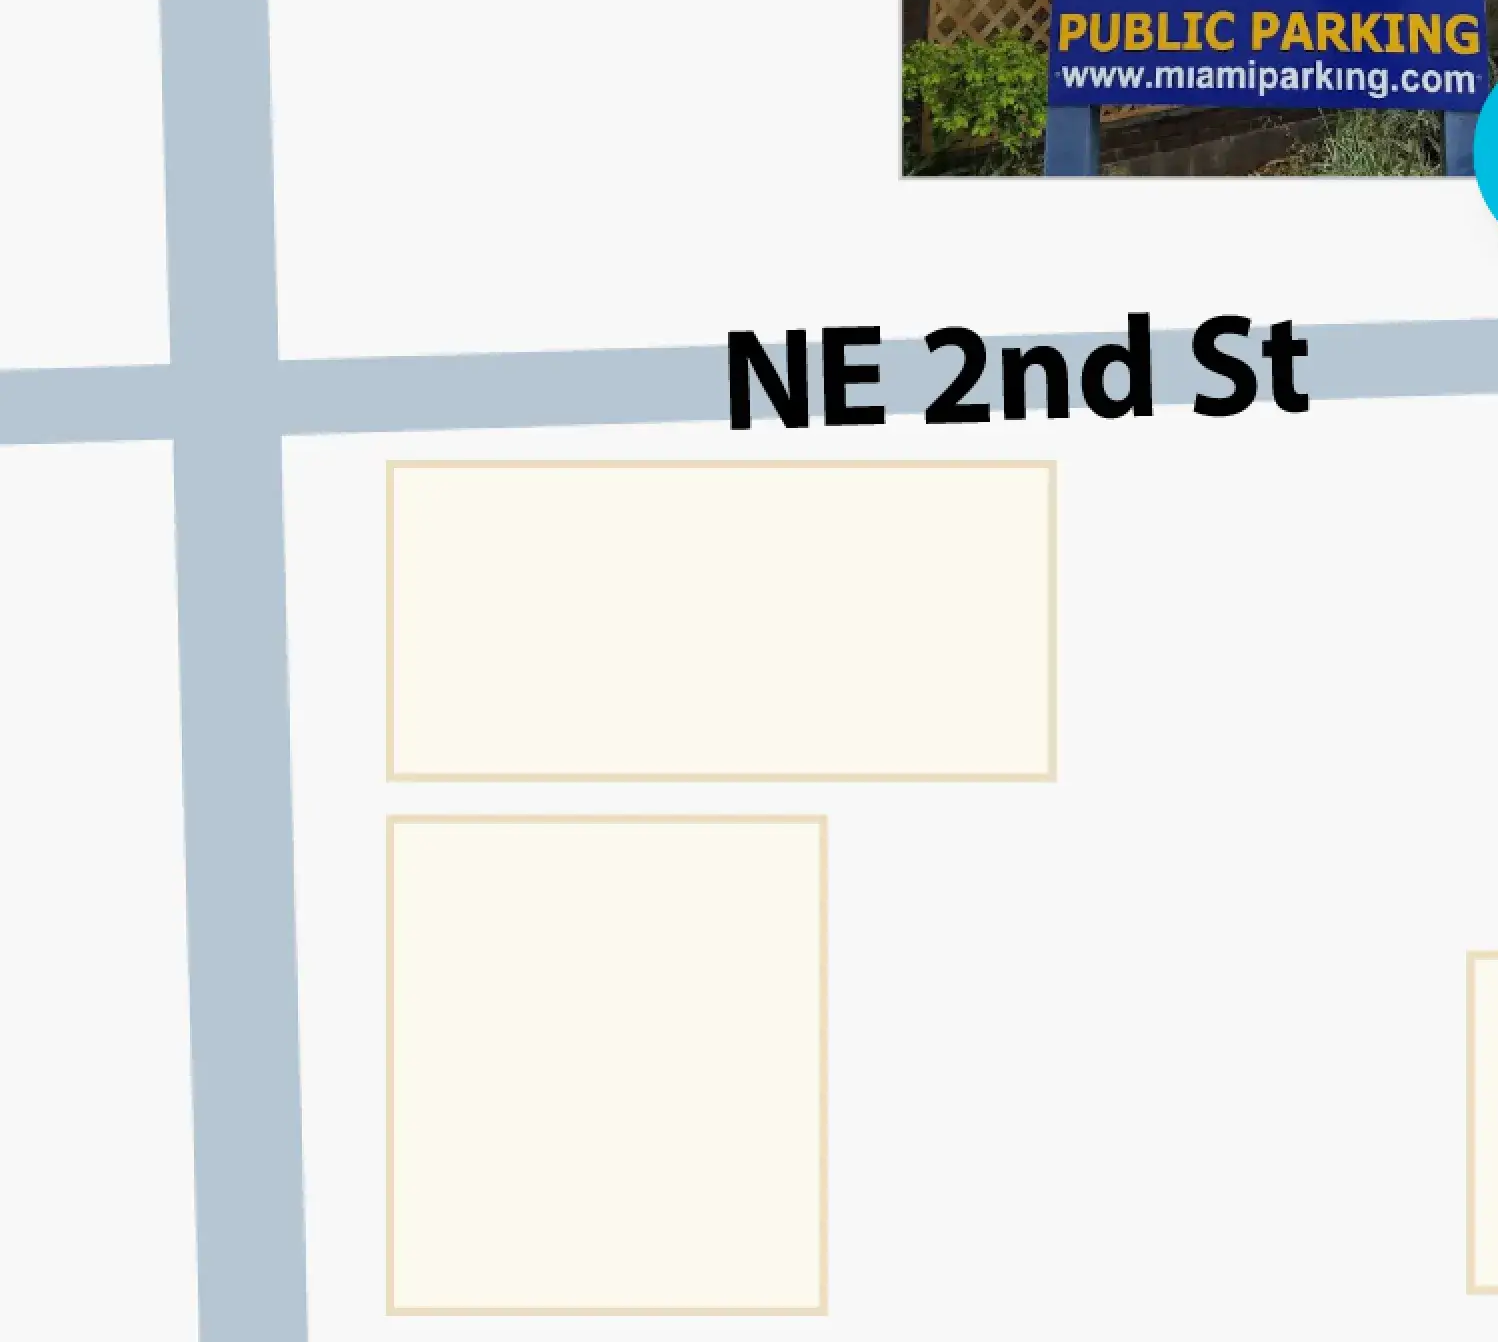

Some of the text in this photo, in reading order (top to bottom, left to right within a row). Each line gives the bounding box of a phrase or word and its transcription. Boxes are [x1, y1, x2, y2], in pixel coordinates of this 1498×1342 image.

[1058, 12, 1481, 55] PUBLIC PARKING
[1062, 60, 1477, 99] www.miamiparking.com
[726, 310, 1310, 432] NE 2nd St
